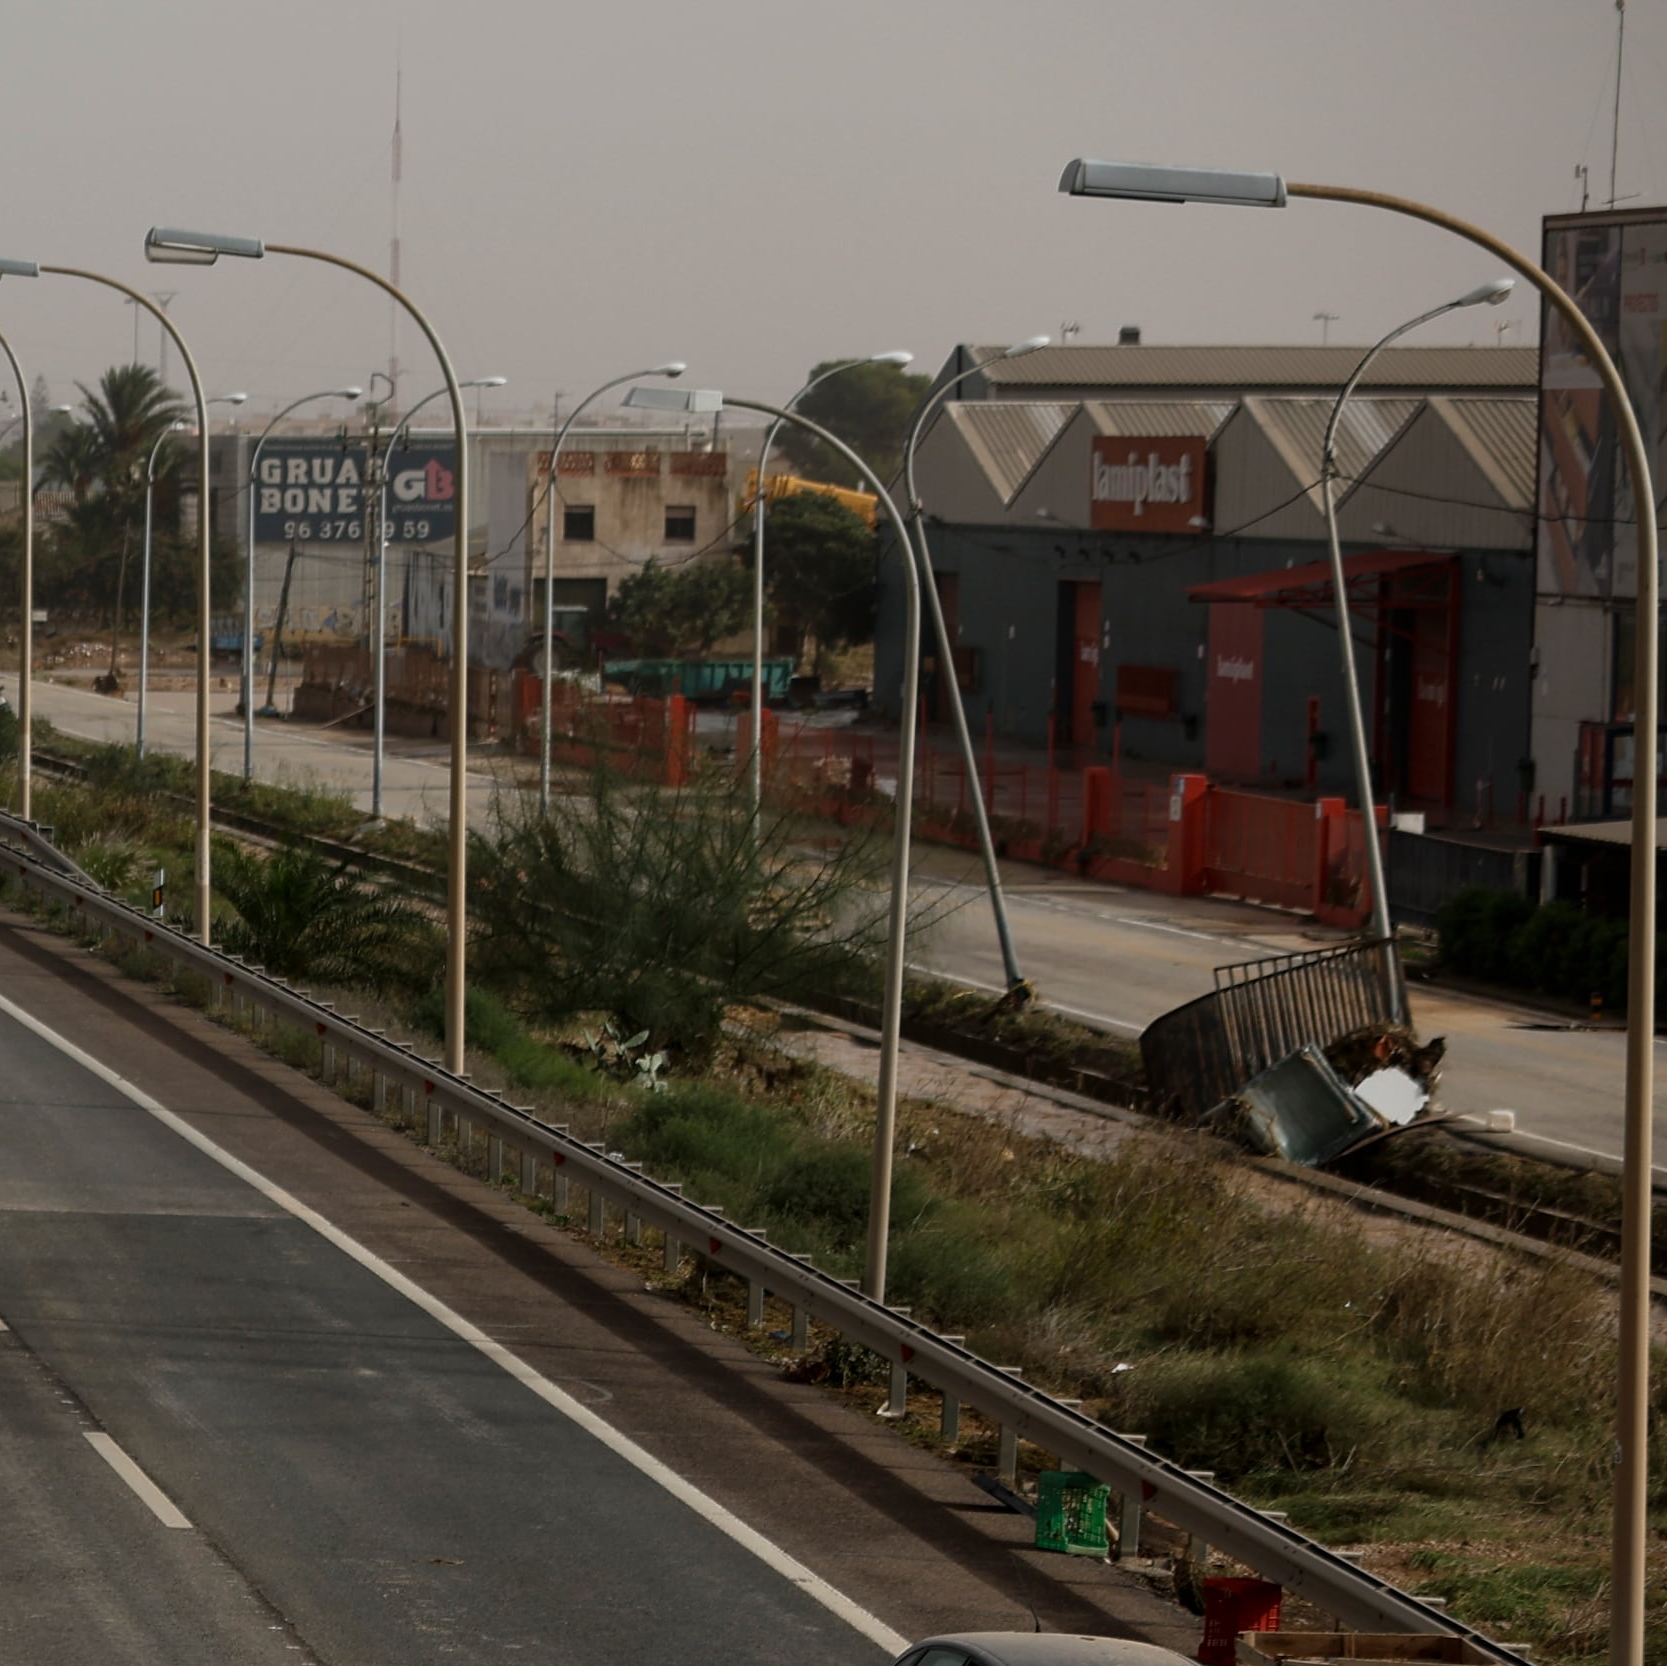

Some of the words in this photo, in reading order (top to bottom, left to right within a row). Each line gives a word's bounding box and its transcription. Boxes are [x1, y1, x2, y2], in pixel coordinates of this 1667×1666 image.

[1092, 451, 1193, 516] lamiplast
[284, 521, 312, 539] 96
[319, 521, 361, 539] 376
[403, 521, 430, 539] 59
